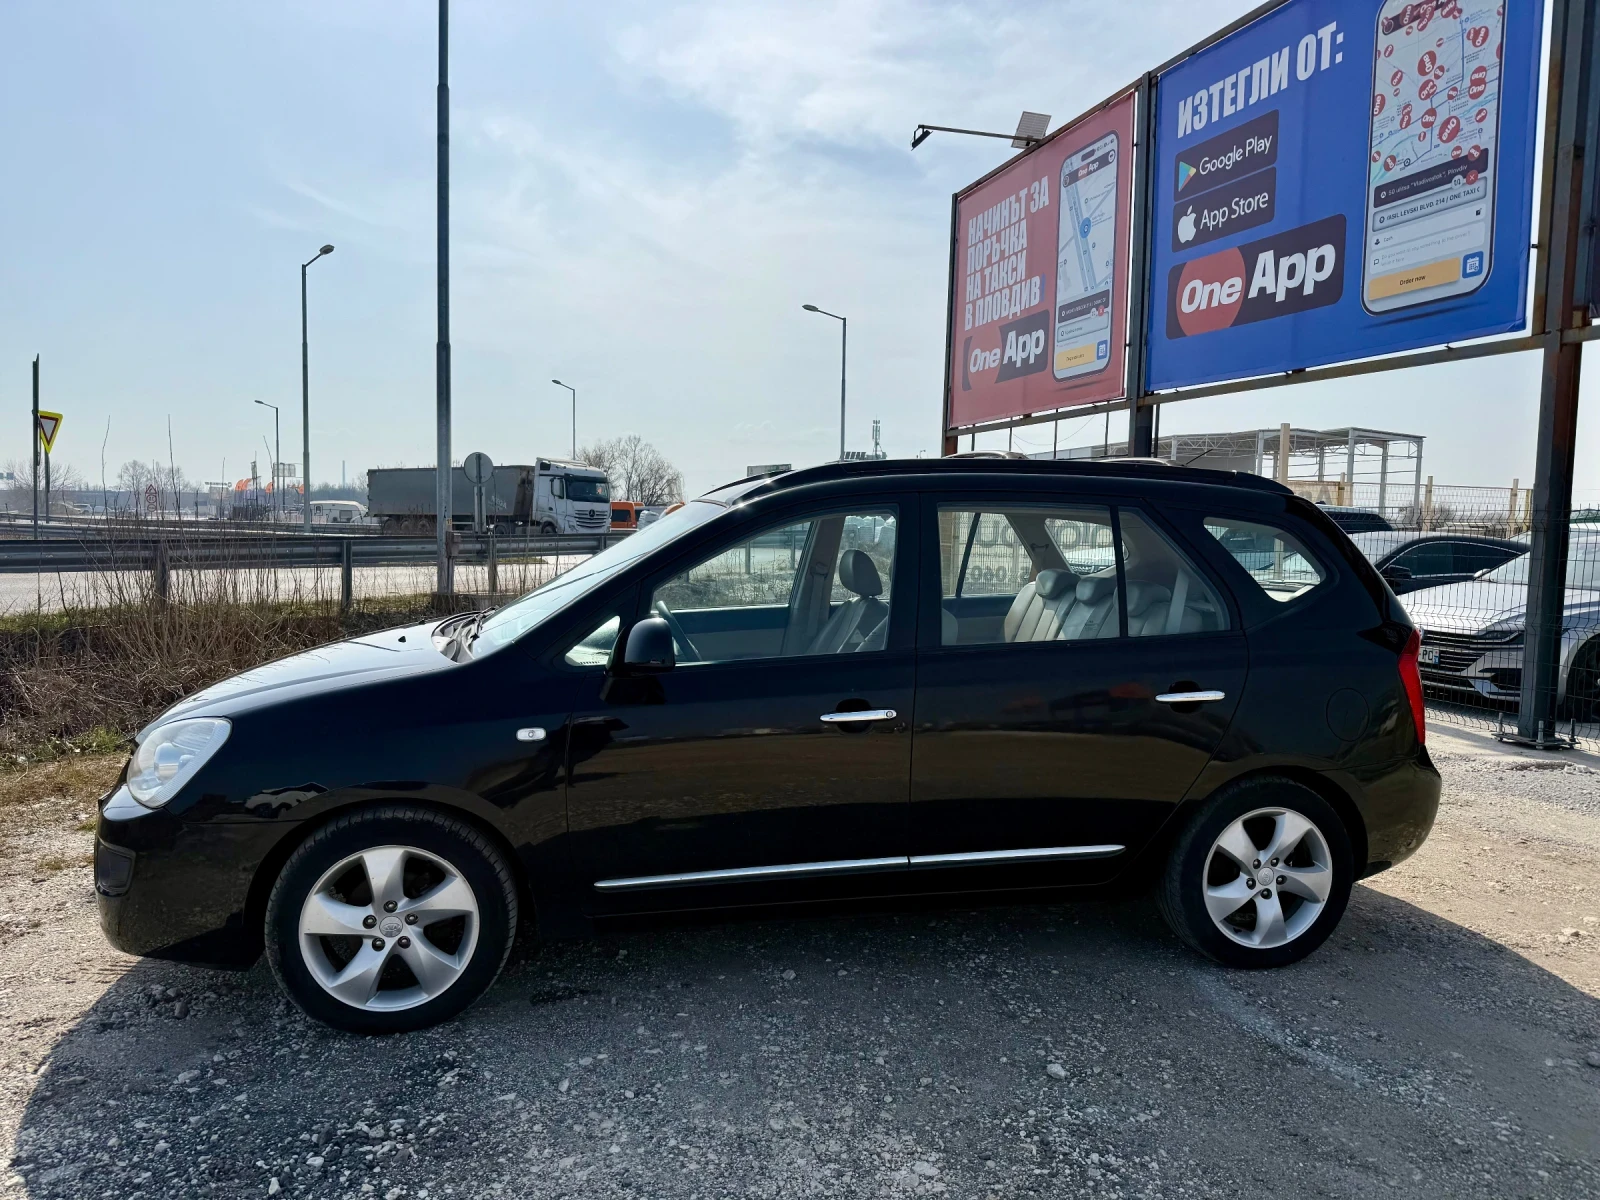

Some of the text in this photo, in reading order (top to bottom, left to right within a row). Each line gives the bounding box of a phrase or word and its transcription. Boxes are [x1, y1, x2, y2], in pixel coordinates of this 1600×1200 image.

[1403, 5, 1412, 24] One
[1475, 27, 1486, 46] One
[1423, 54, 1433, 73] One
[1177, 21, 1344, 139] ИЗТЕГЛИ ОТ:
[1392, 71, 1402, 86] One
[1469, 84, 1486, 95] One
[1373, 95, 1382, 115] One
[1441, 117, 1457, 141] One
[1199, 135, 1273, 176] Google Play
[1447, 164, 1468, 175] Plovdiv
[968, 175, 1049, 247] НАЧИНЪТ ЗА
[1200, 192, 1269, 231] App Store
[1400, 206, 1419, 216] LEVSKI
[1435, 197, 1445, 206] 214
[1449, 192, 1462, 201] ONE
[1463, 188, 1476, 197] TAXI
[966, 218, 1028, 276] ПОРЪЧКА
[966, 249, 1026, 303] НА ТАКСИ
[1180, 244, 1336, 313] One App
[1399, 277, 1414, 286] Order
[965, 303, 973, 331] В
[969, 328, 1045, 374] One App
